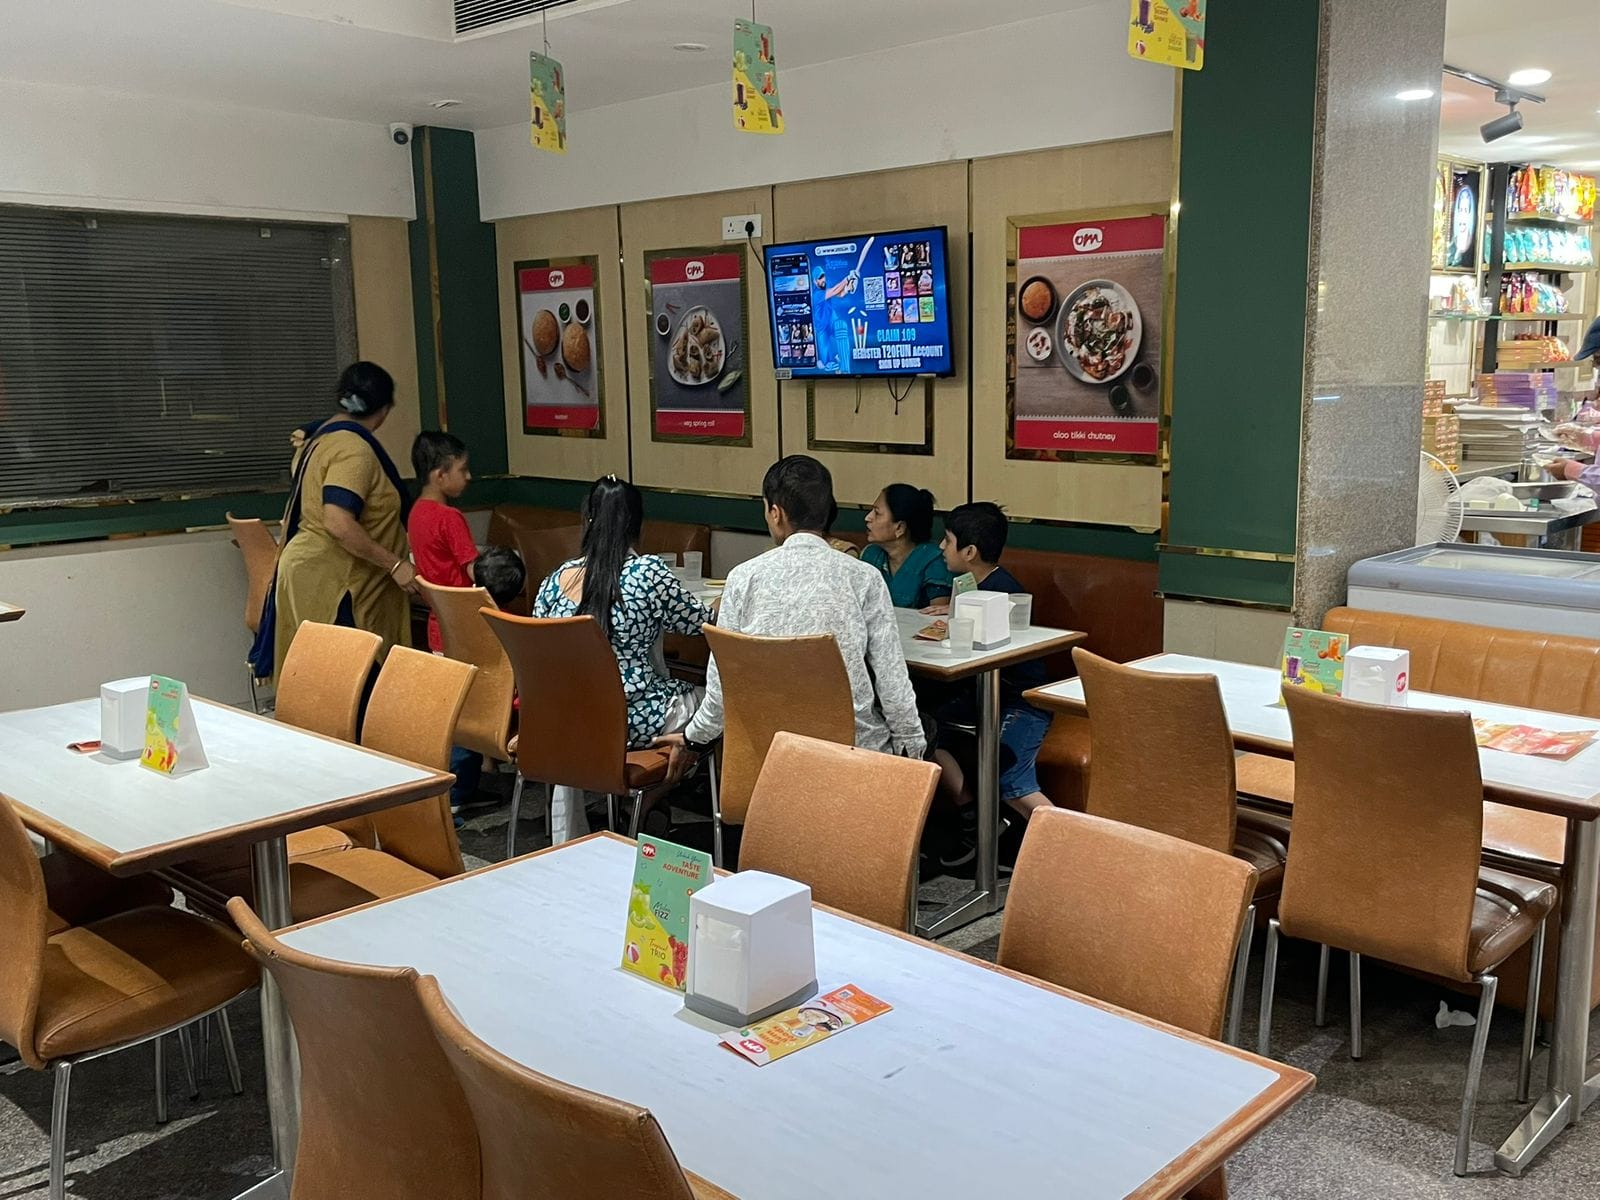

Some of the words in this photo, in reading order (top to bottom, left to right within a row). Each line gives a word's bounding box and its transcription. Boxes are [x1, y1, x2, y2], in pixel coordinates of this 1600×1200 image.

[877, 328, 900, 342] CLAIM
[901, 327, 916, 342] 109
[881, 343, 911, 358] T20FUN
[912, 345, 944, 357] ACCOUNT
[1052, 430, 1069, 439] aloo
[1070, 431, 1086, 439] tikki
[1087, 431, 1116, 442] chutney
[662, 862, 700, 880] ADVENTURE
[681, 860, 701, 872] TASTE
[654, 909, 670, 921] FIZZ
[650, 947, 666, 960] TRIO
